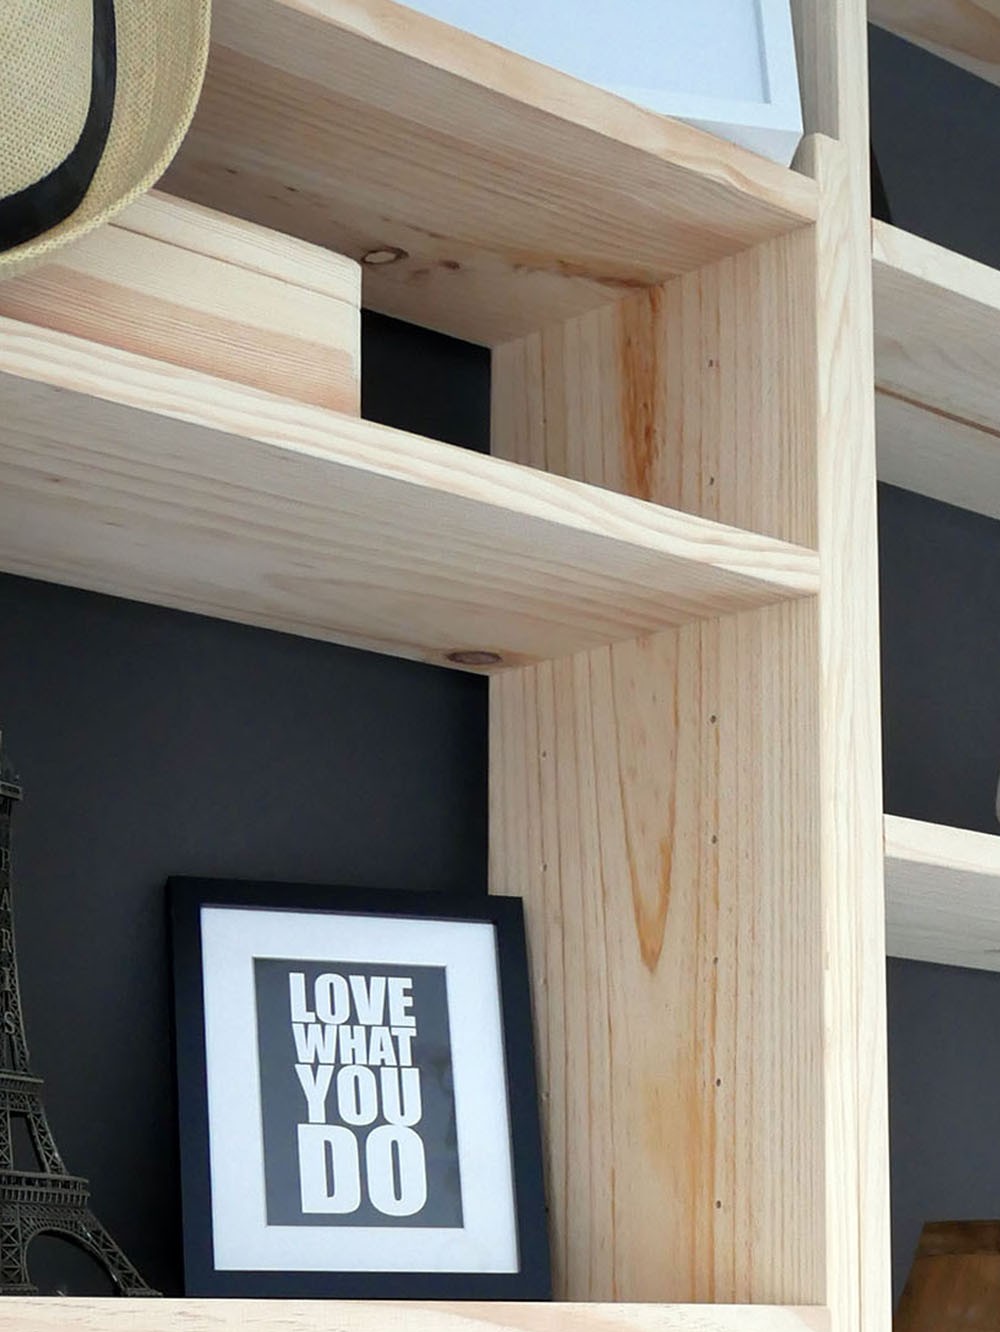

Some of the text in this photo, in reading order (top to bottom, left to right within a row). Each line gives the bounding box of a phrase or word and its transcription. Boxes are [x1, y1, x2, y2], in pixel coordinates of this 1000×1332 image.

[289, 972, 417, 1027] LOVE
[292, 1023, 417, 1067] WHAT
[295, 1064, 423, 1127] YOU
[297, 1123, 428, 1217] DO
